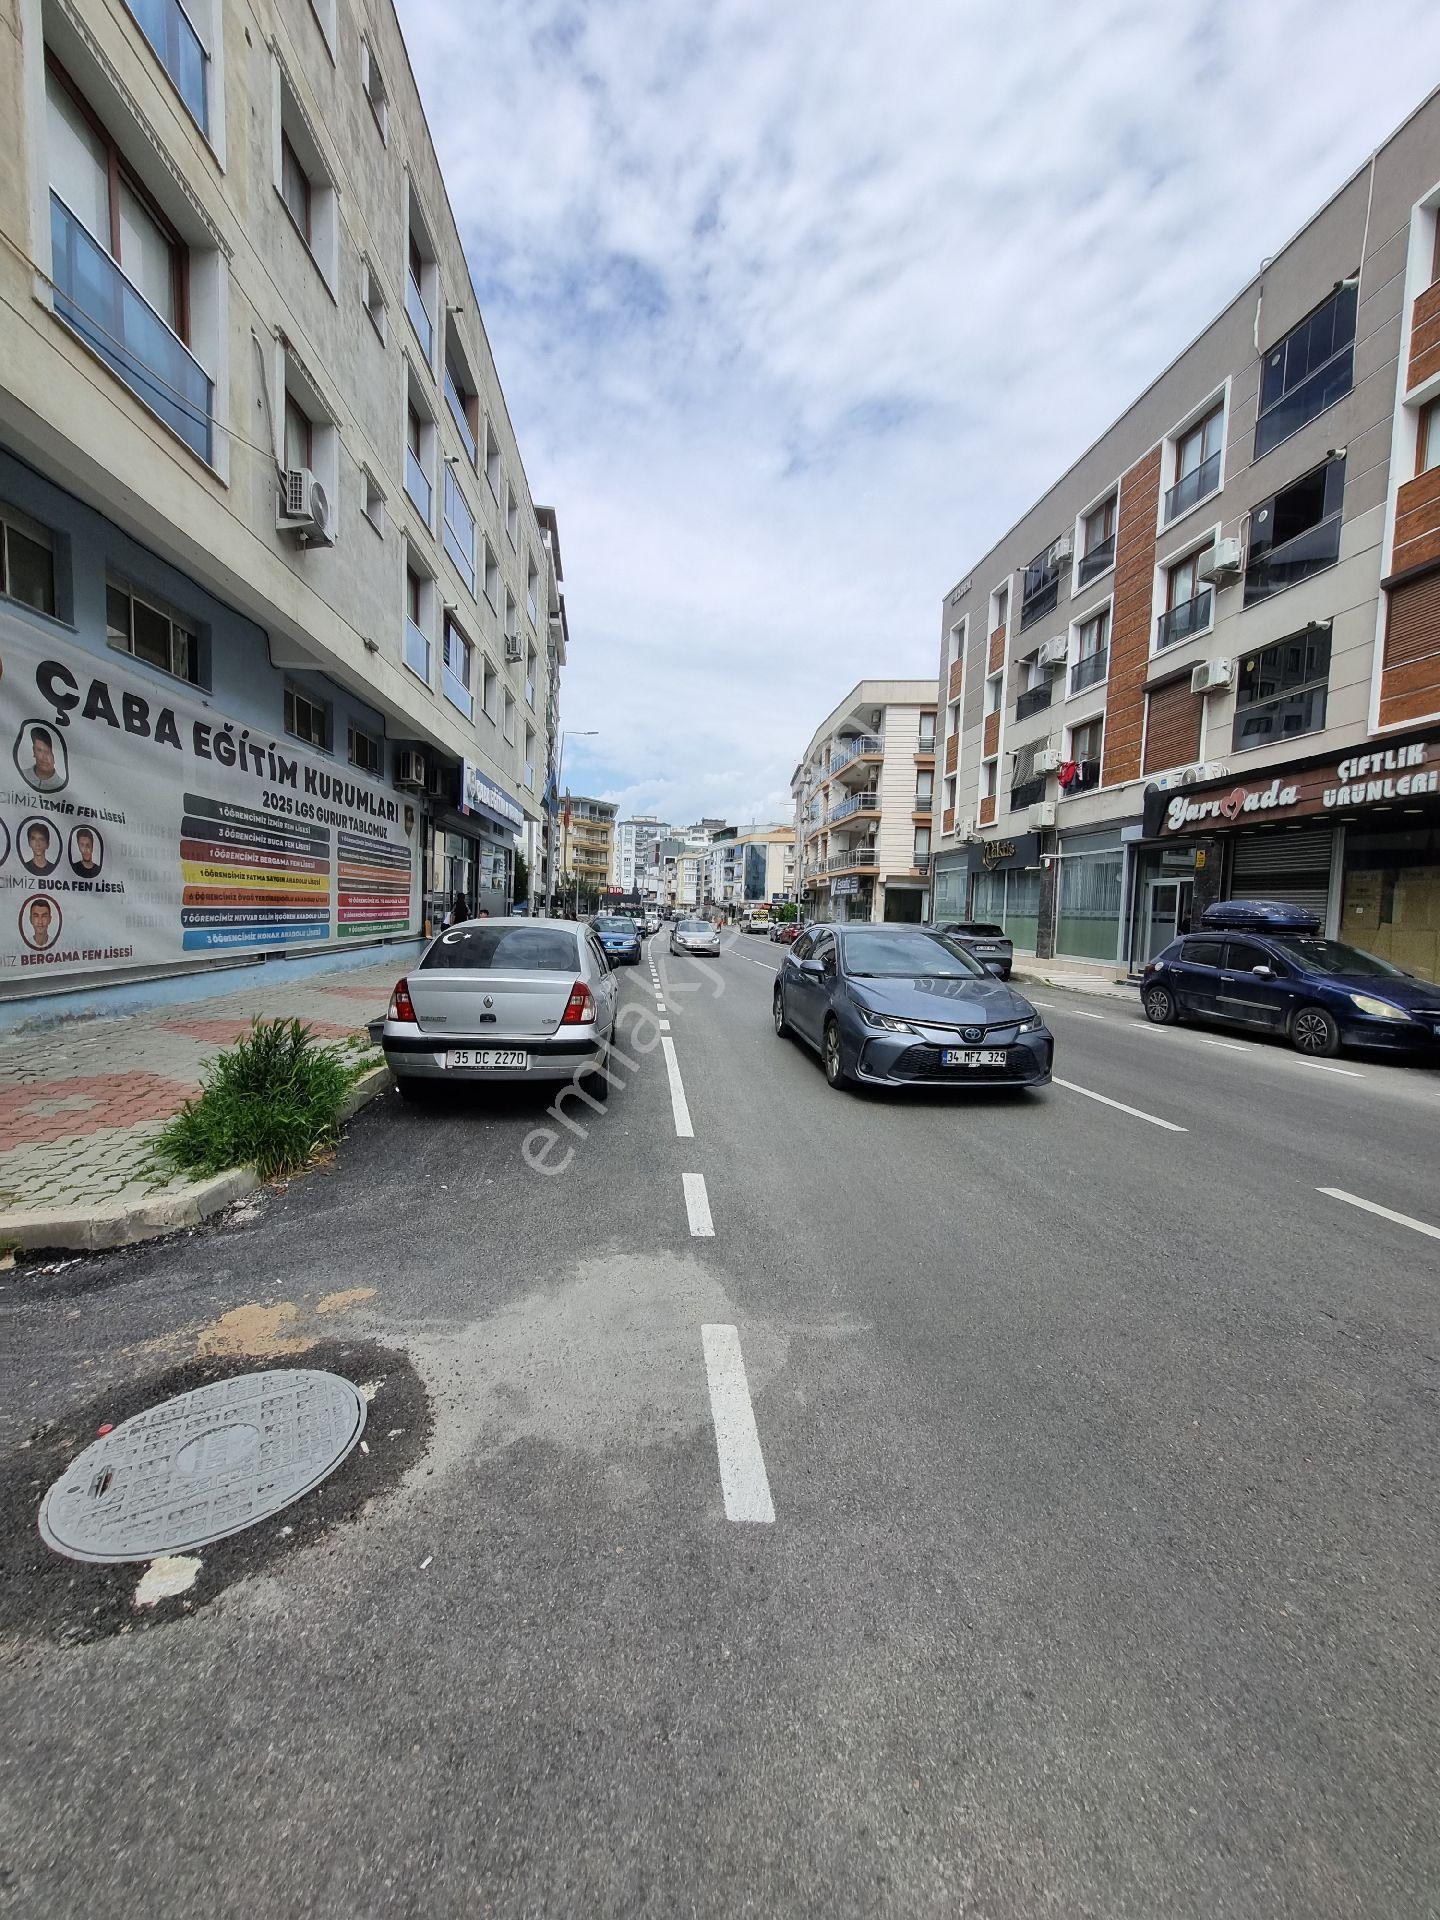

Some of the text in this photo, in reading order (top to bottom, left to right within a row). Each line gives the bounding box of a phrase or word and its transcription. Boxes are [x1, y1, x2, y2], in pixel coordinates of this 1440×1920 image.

[36, 660, 399, 823] ÇABA EĞİTİM KURUMLARI
[1337, 743, 1426, 783] ÇİFTLİK
[1322, 770, 1438, 808] ÜRÜNLERİ
[39, 795, 74, 815] İZMİR
[77, 806, 97, 819] FEN
[99, 808, 126, 824] LİSESİ
[262, 790, 388, 839] 2025 LGS GURUR TABLOMUZ
[38, 880, 70, 890] BUCA
[72, 881, 93, 892] FEN
[95, 879, 125, 893] LİSESİ
[20, 951, 80, 966] BERGAMA
[82, 949, 102, 960] FEN
[103, 945, 133, 959] LİSESİ
[454, 1051, 524, 1065] 35 DC 2270
[948, 1051, 1006, 1062] 34 MFZ 329
